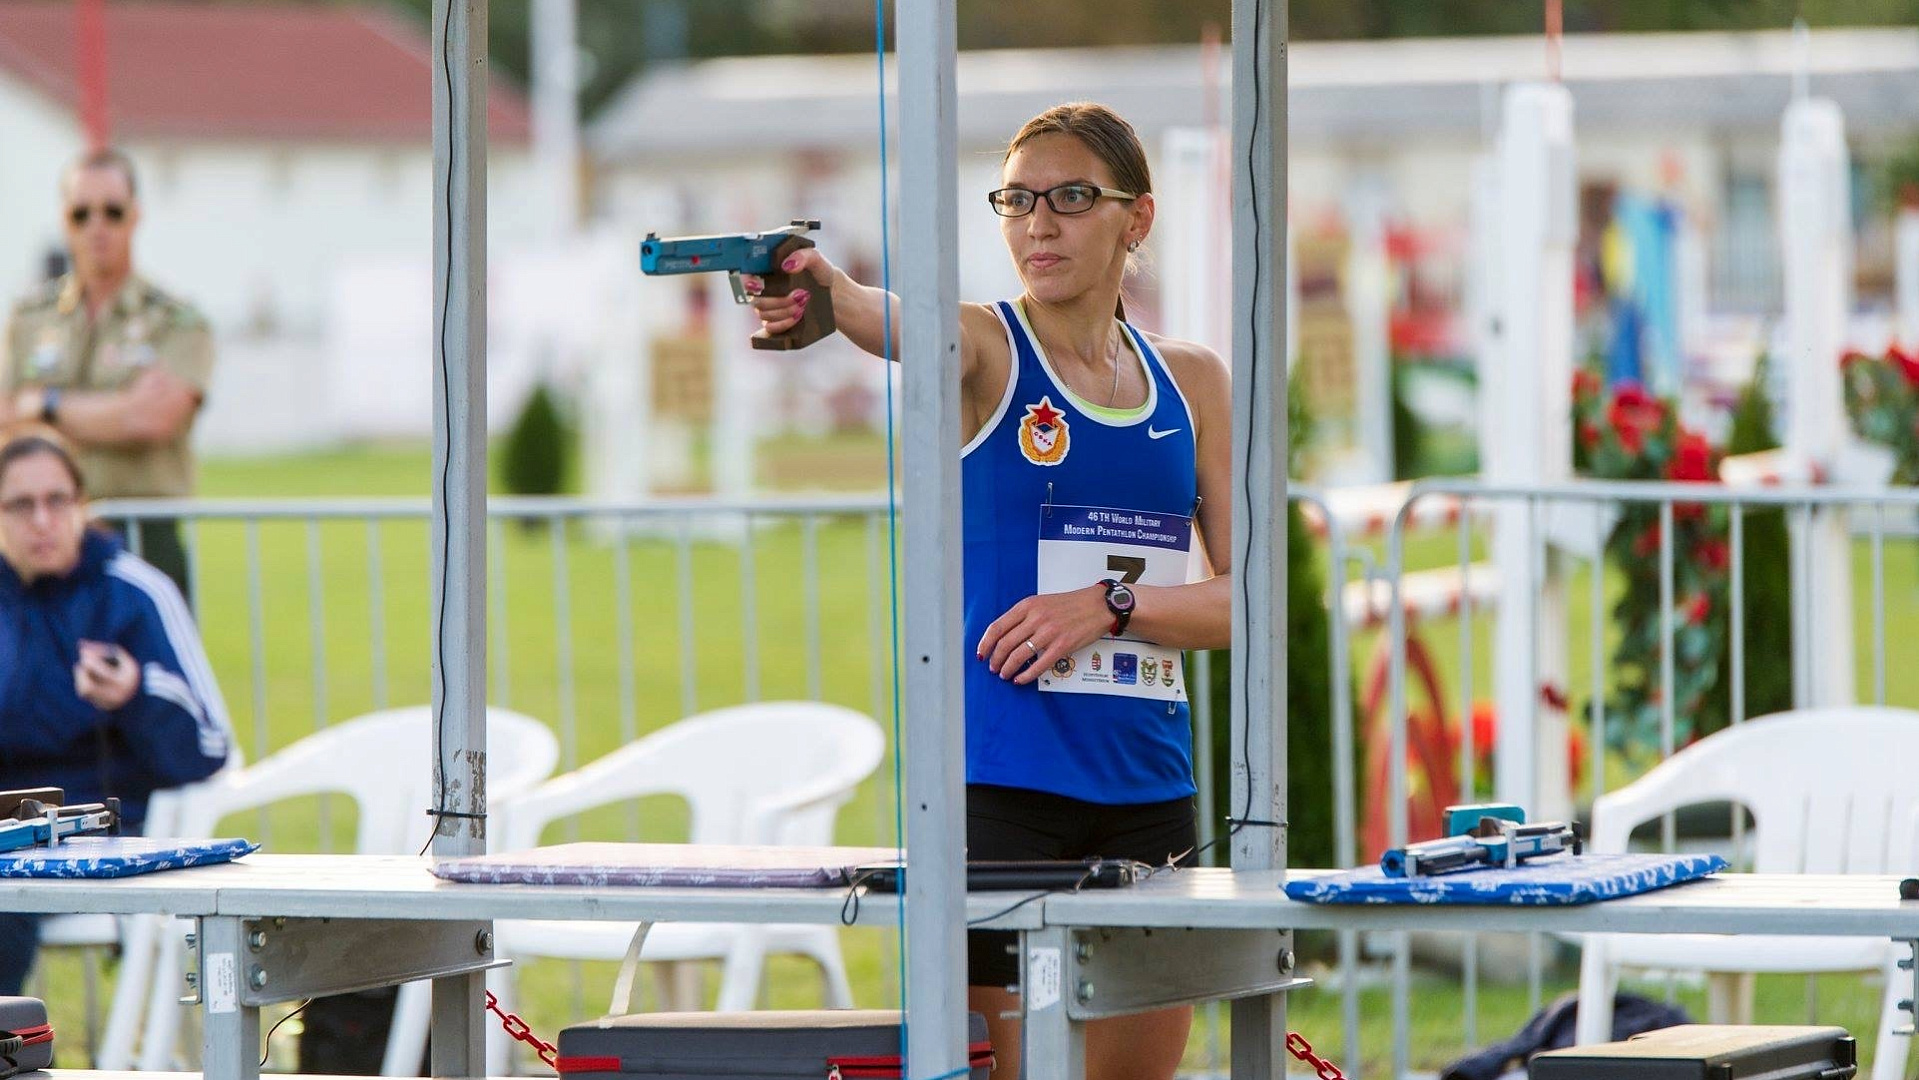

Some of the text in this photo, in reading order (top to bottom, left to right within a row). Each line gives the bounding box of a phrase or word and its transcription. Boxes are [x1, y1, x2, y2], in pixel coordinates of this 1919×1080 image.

[1088, 512, 1161, 527] 46 TH WORLD MILITARY
[1064, 524, 1095, 535] MODERN
[1097, 525, 1136, 539] PENTATHLON
